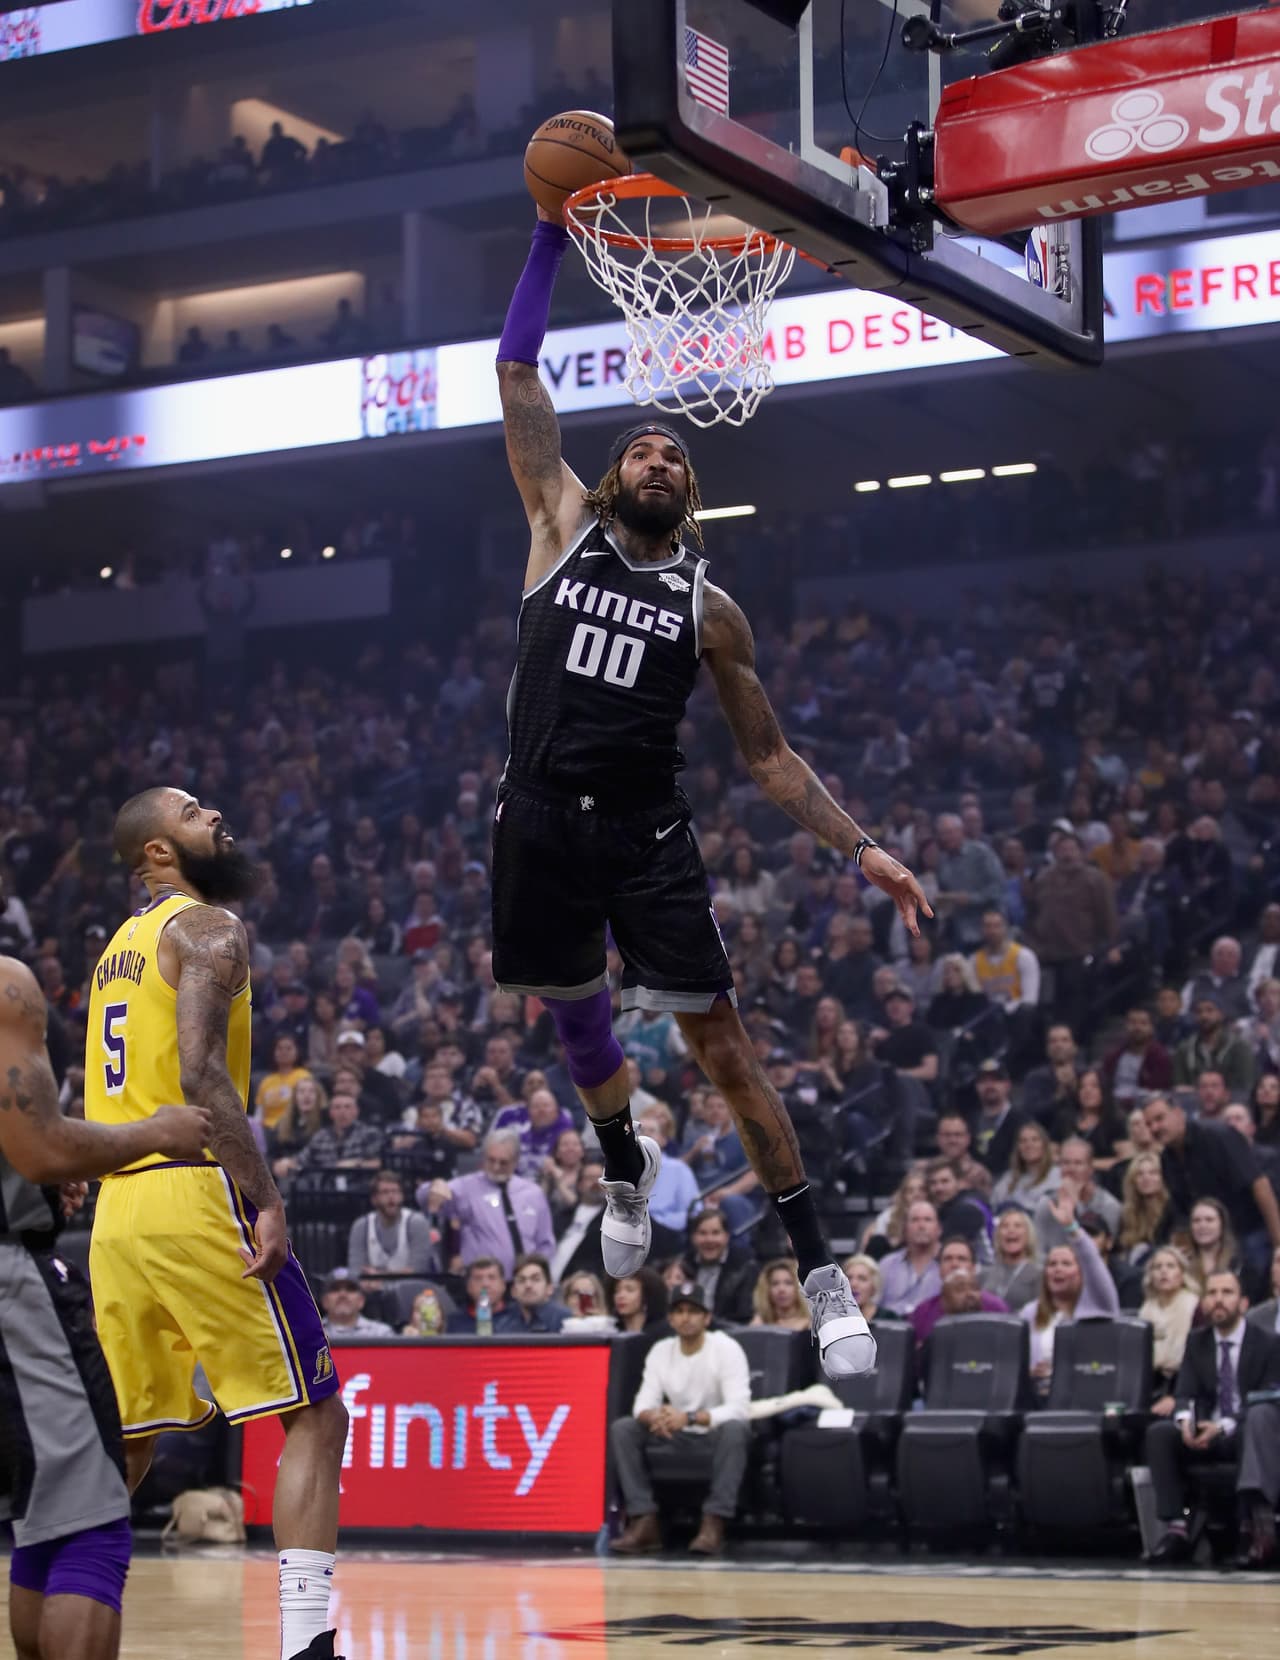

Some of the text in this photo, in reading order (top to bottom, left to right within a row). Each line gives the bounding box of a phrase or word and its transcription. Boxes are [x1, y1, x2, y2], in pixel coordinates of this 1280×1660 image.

[554, 578, 684, 642] KINGS
[565, 622, 646, 689] 00
[97, 950, 146, 991] CHANDLER
[103, 1001, 128, 1097] 5
[339, 1373, 571, 1496] finity
